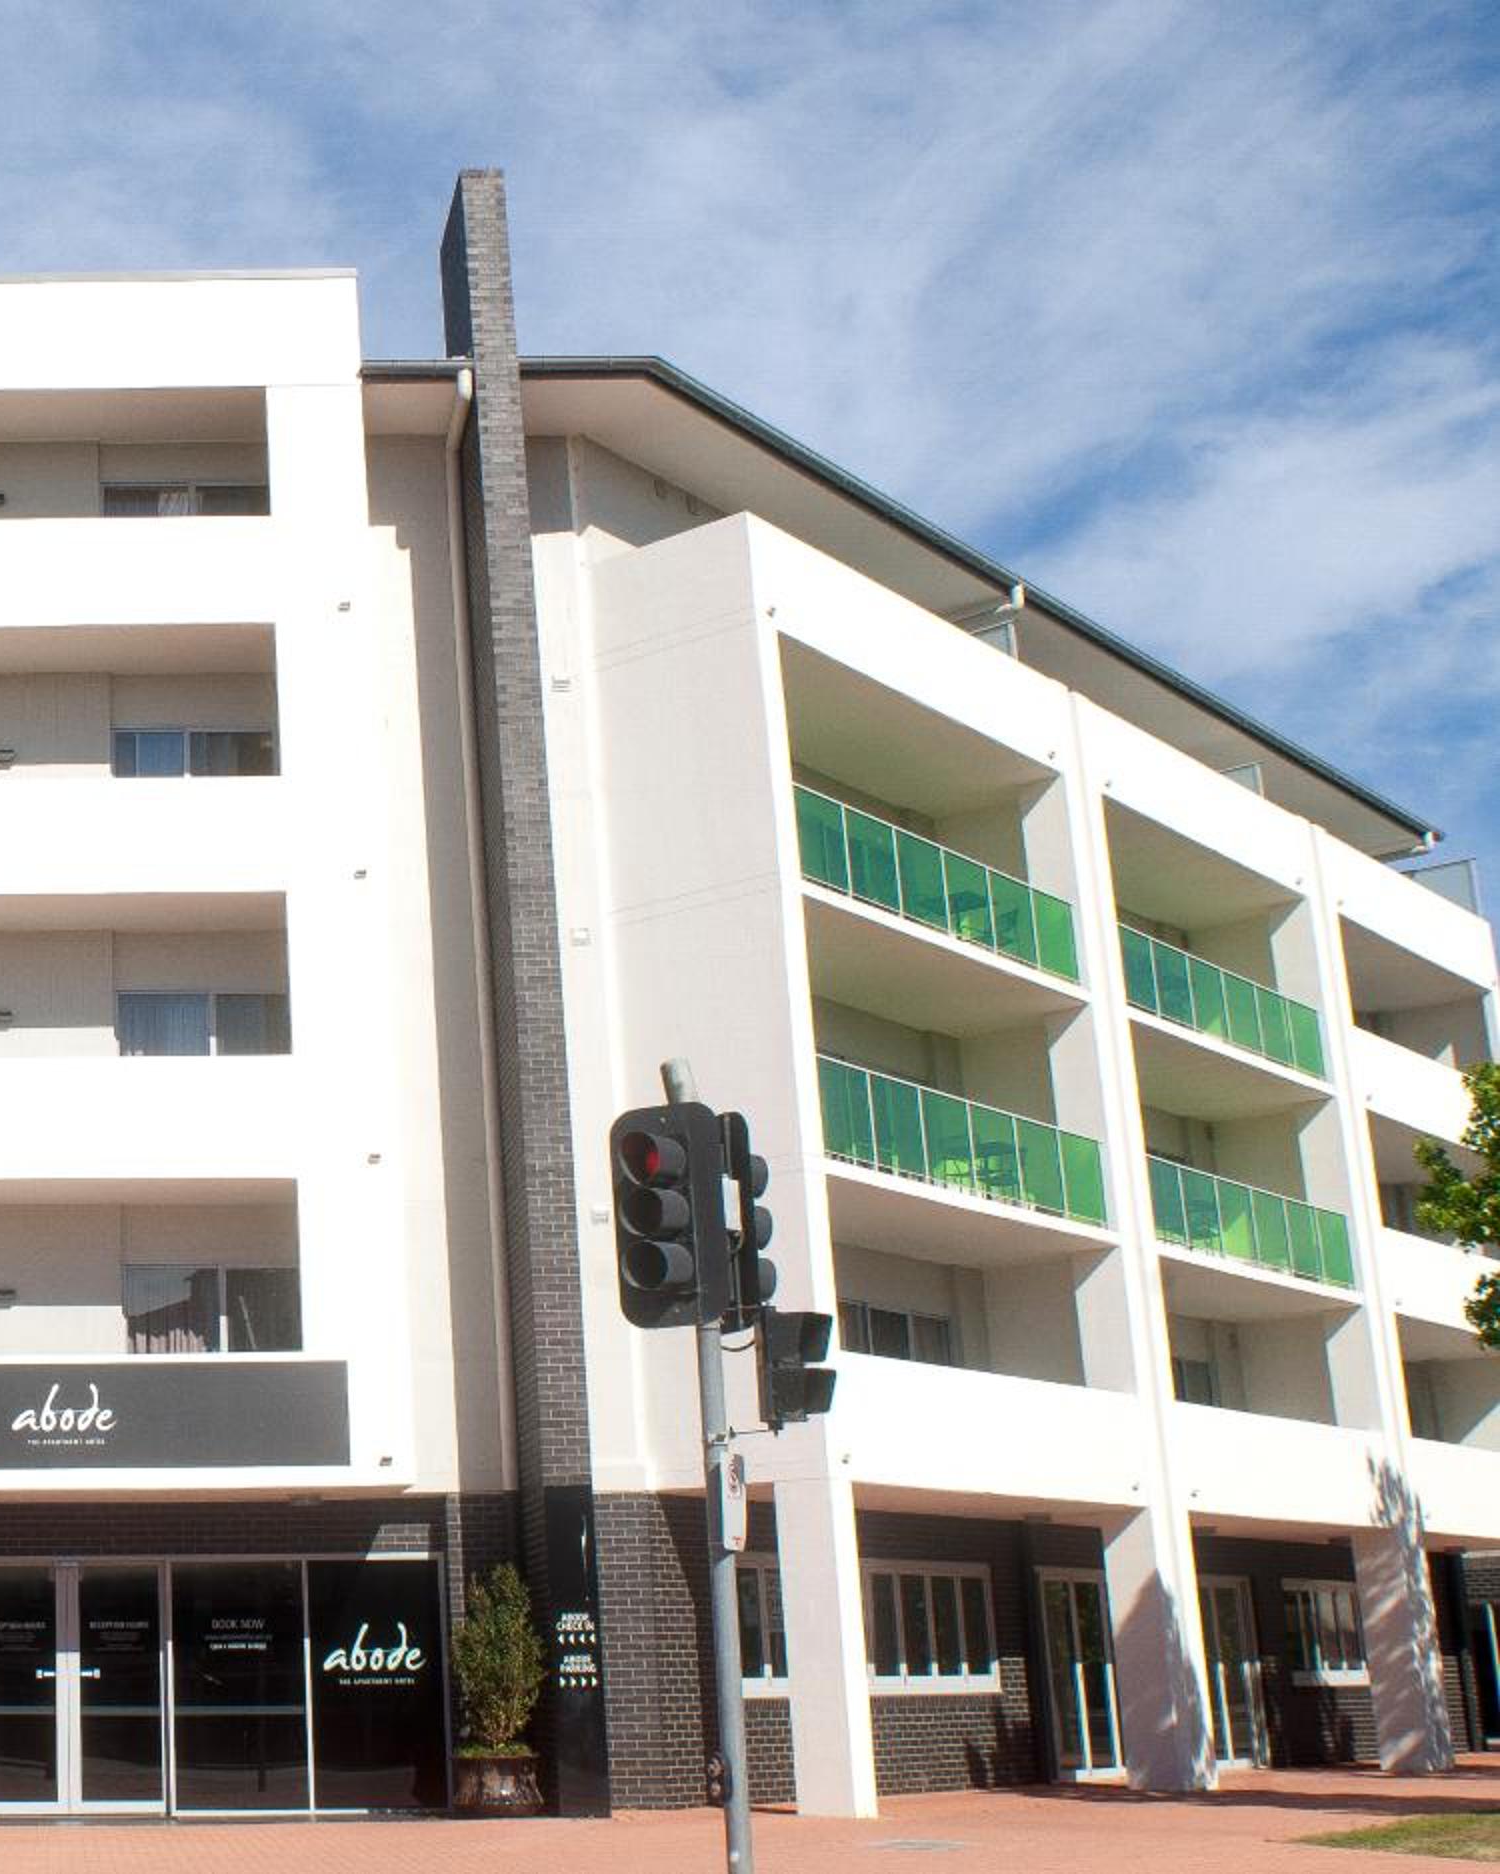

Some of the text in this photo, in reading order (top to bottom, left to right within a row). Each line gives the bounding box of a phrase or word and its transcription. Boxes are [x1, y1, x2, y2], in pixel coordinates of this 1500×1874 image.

[11, 1383, 117, 1432] abode
[211, 1618, 266, 1630] BOOK NOW
[323, 1621, 427, 1671] abode
